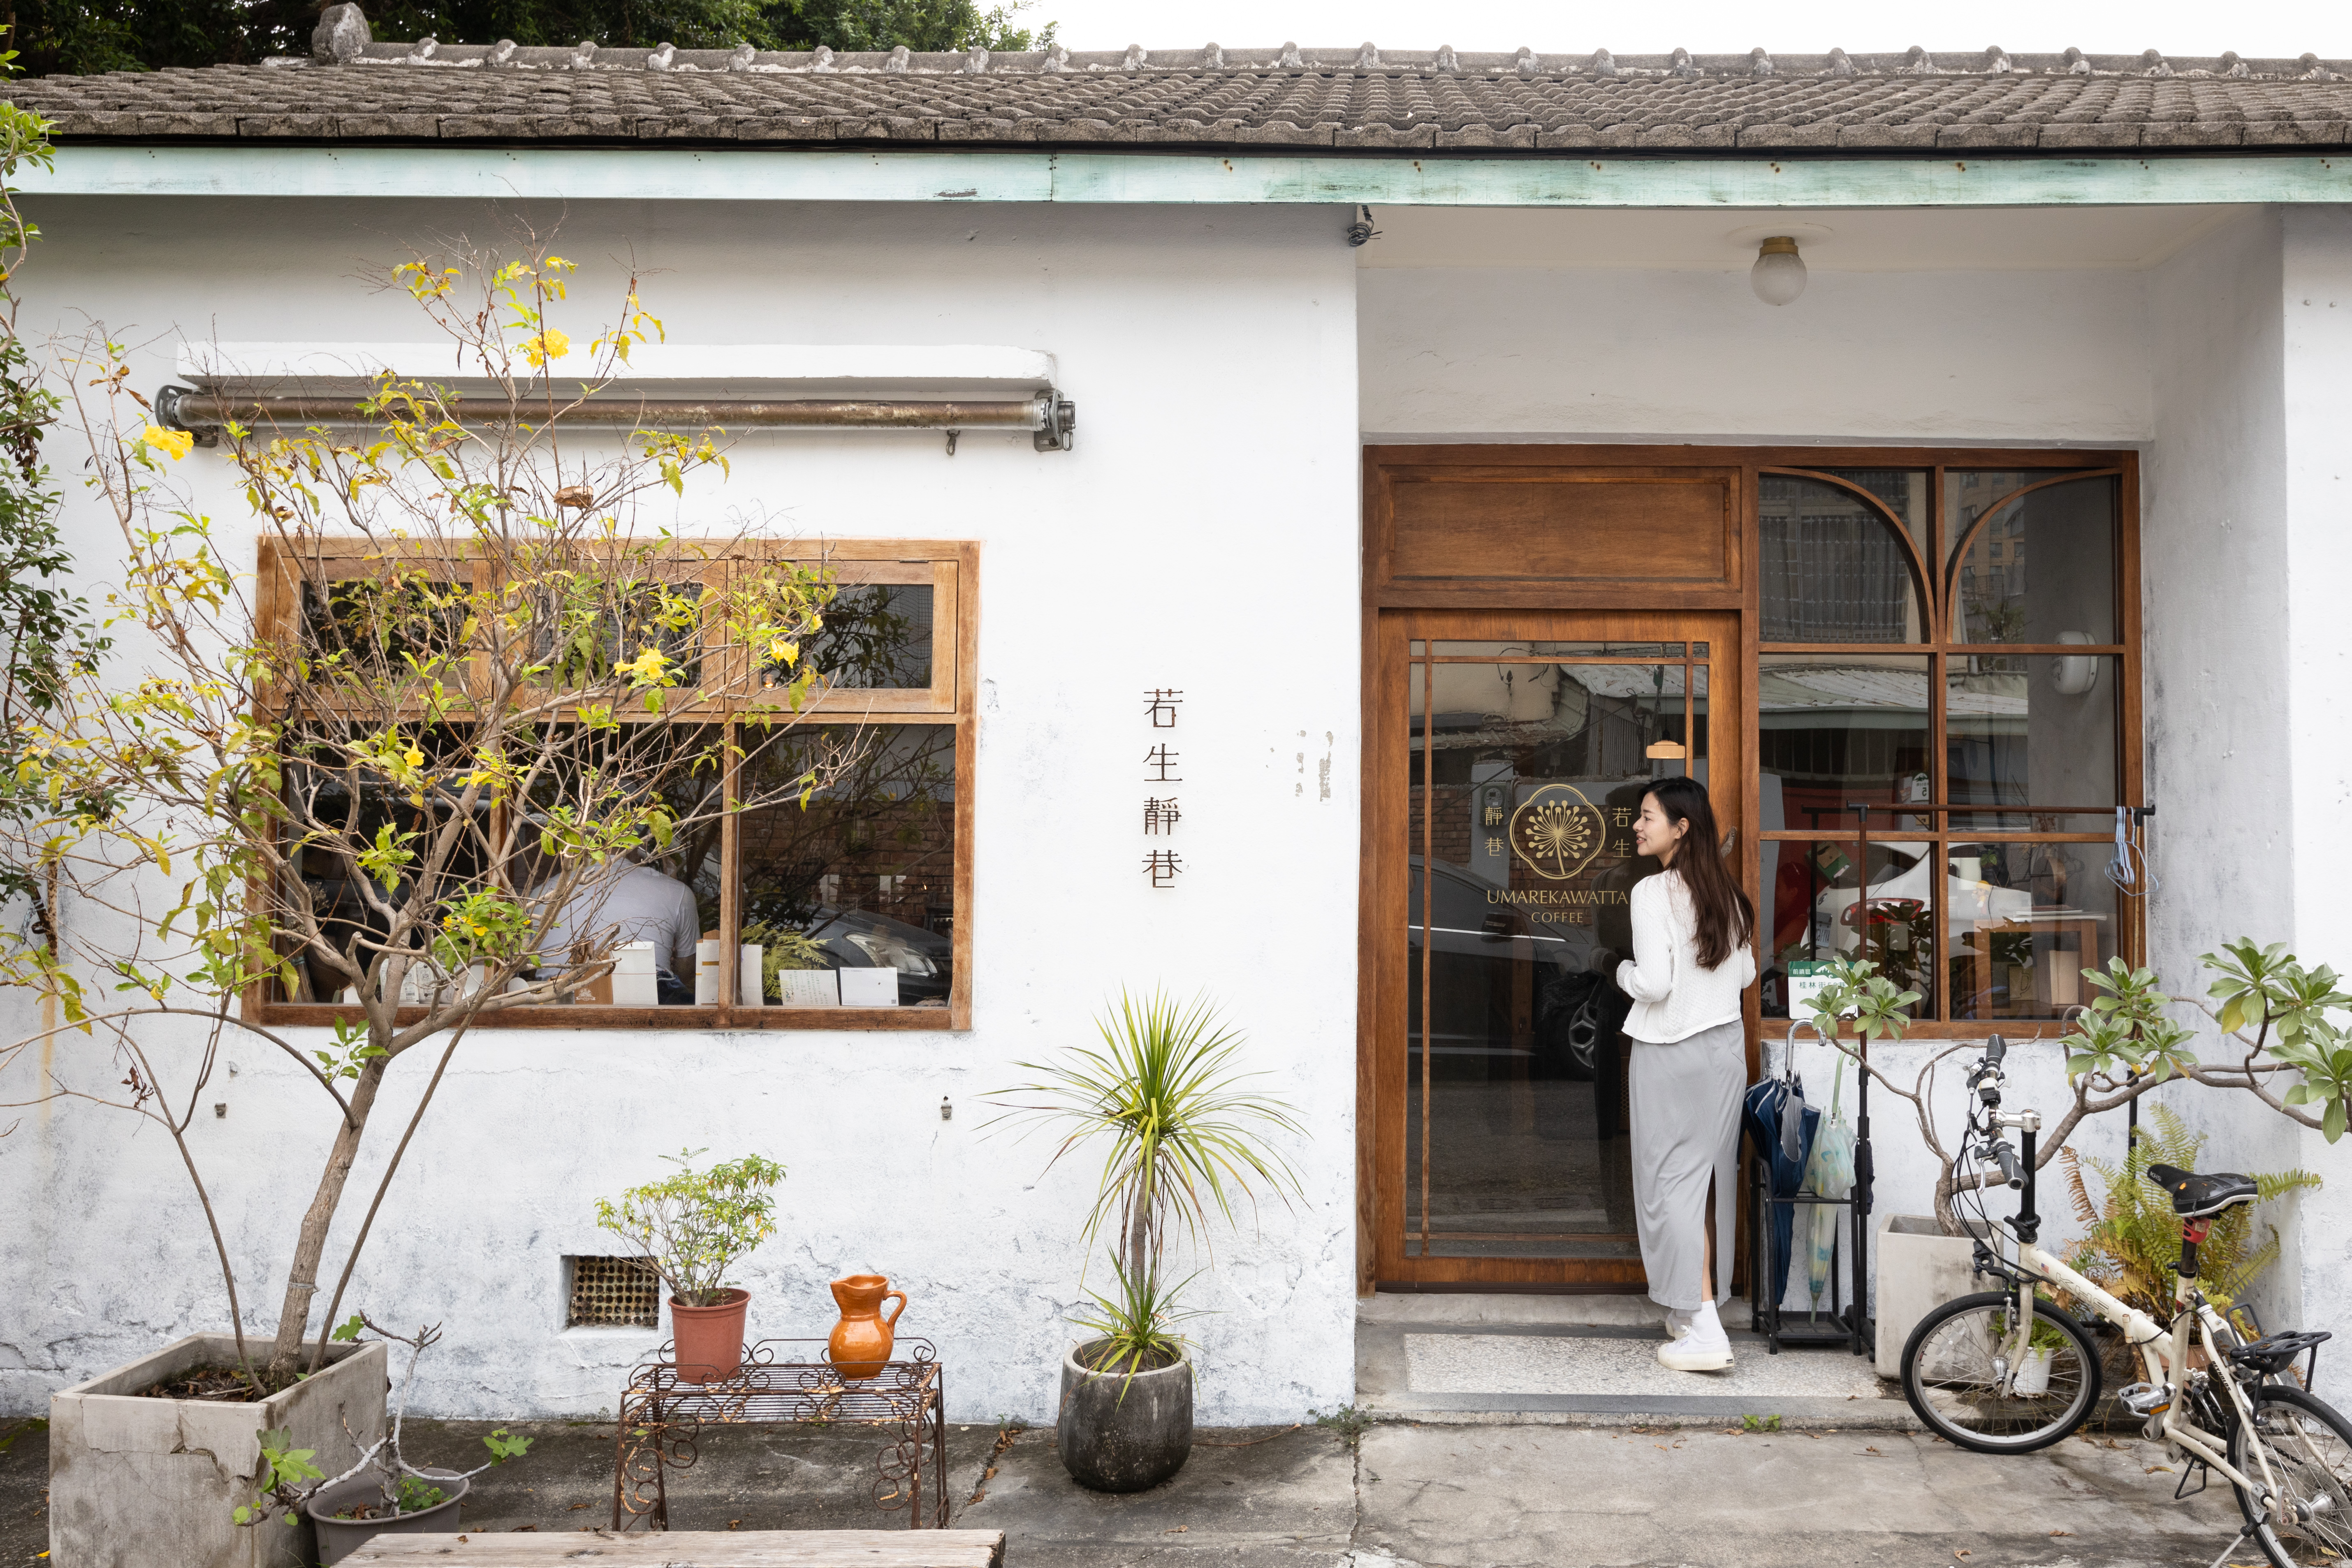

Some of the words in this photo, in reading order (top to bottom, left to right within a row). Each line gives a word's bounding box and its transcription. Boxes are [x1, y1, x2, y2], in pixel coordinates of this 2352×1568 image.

[1142, 688, 1183, 888] 若生靜巷
[1485, 806, 1504, 857] 靜巷
[1612, 807, 1631, 858] 若生
[1488, 889, 1629, 904] UMAREKAWATTA
[1531, 912, 1583, 923] COFFEE
[2150, 1171, 2162, 1181] KHS
[2056, 1272, 2109, 1314] KHS
[2212, 1361, 2231, 1391] REYNOLDS
